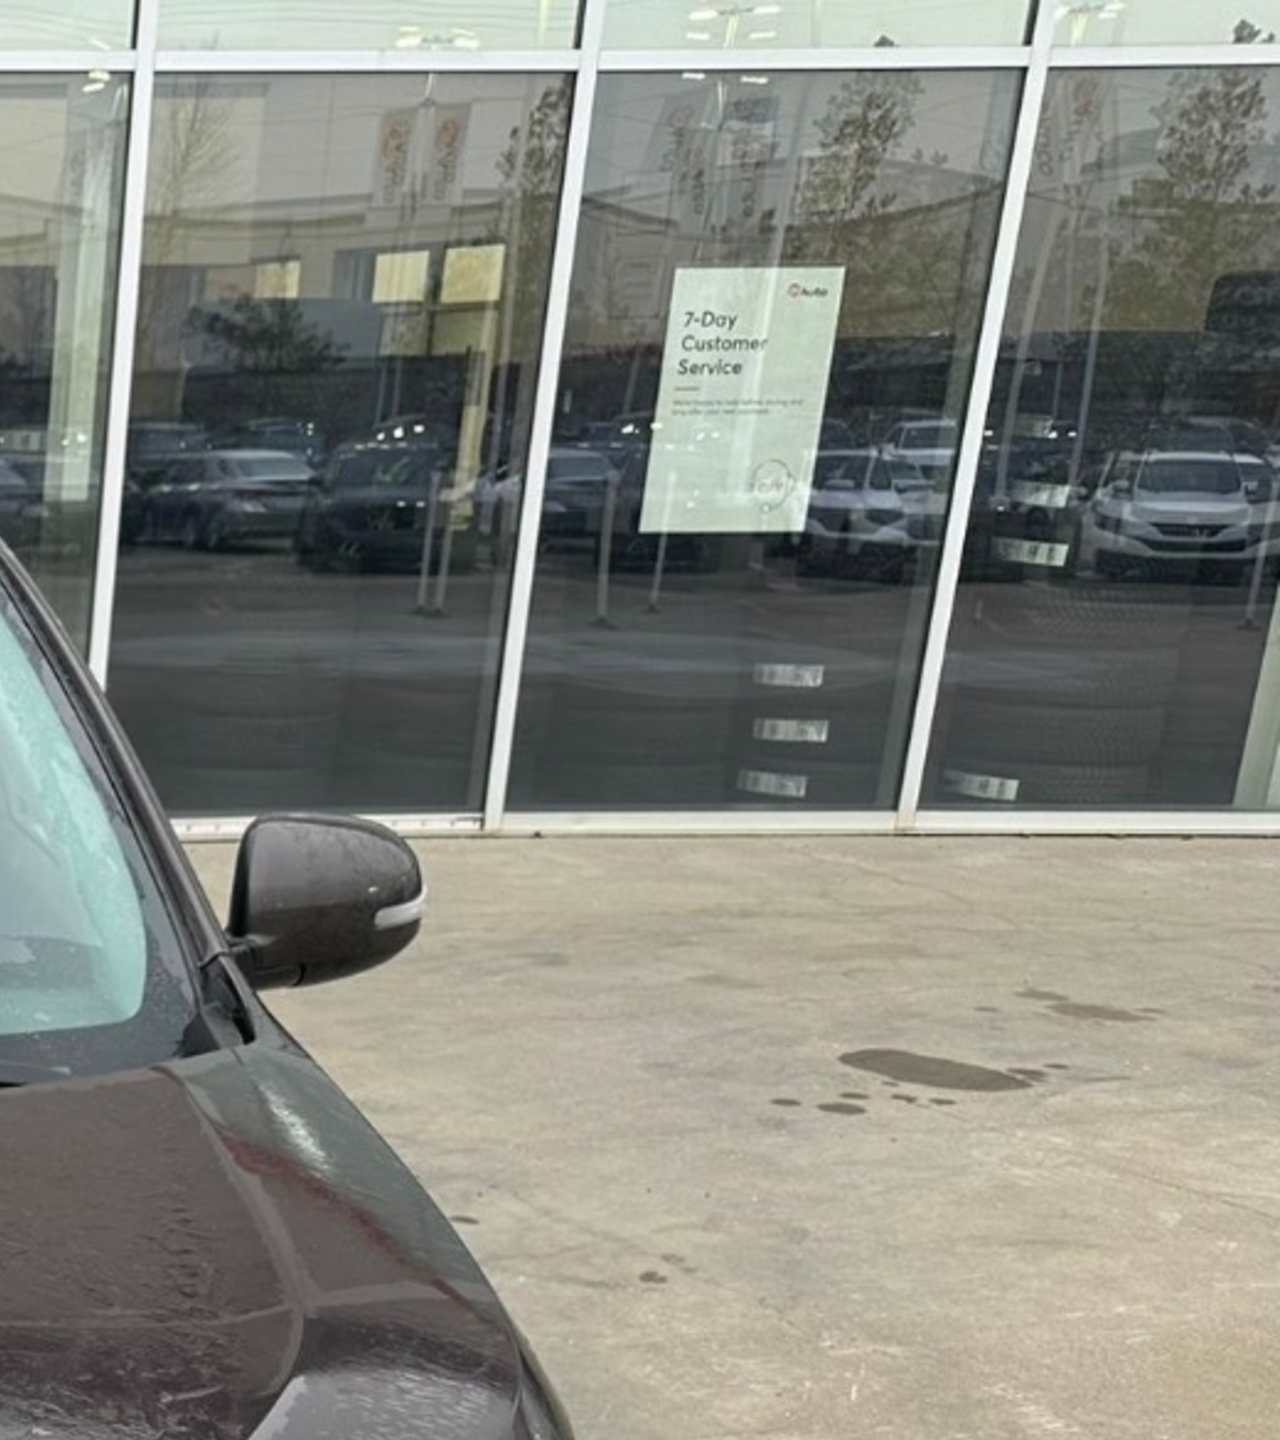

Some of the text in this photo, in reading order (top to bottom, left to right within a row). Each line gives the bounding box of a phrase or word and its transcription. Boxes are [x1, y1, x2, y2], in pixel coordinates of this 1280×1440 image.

[683, 310, 739, 331] 7-Day
[681, 334, 769, 352] Customer
[676, 358, 742, 376] Service
